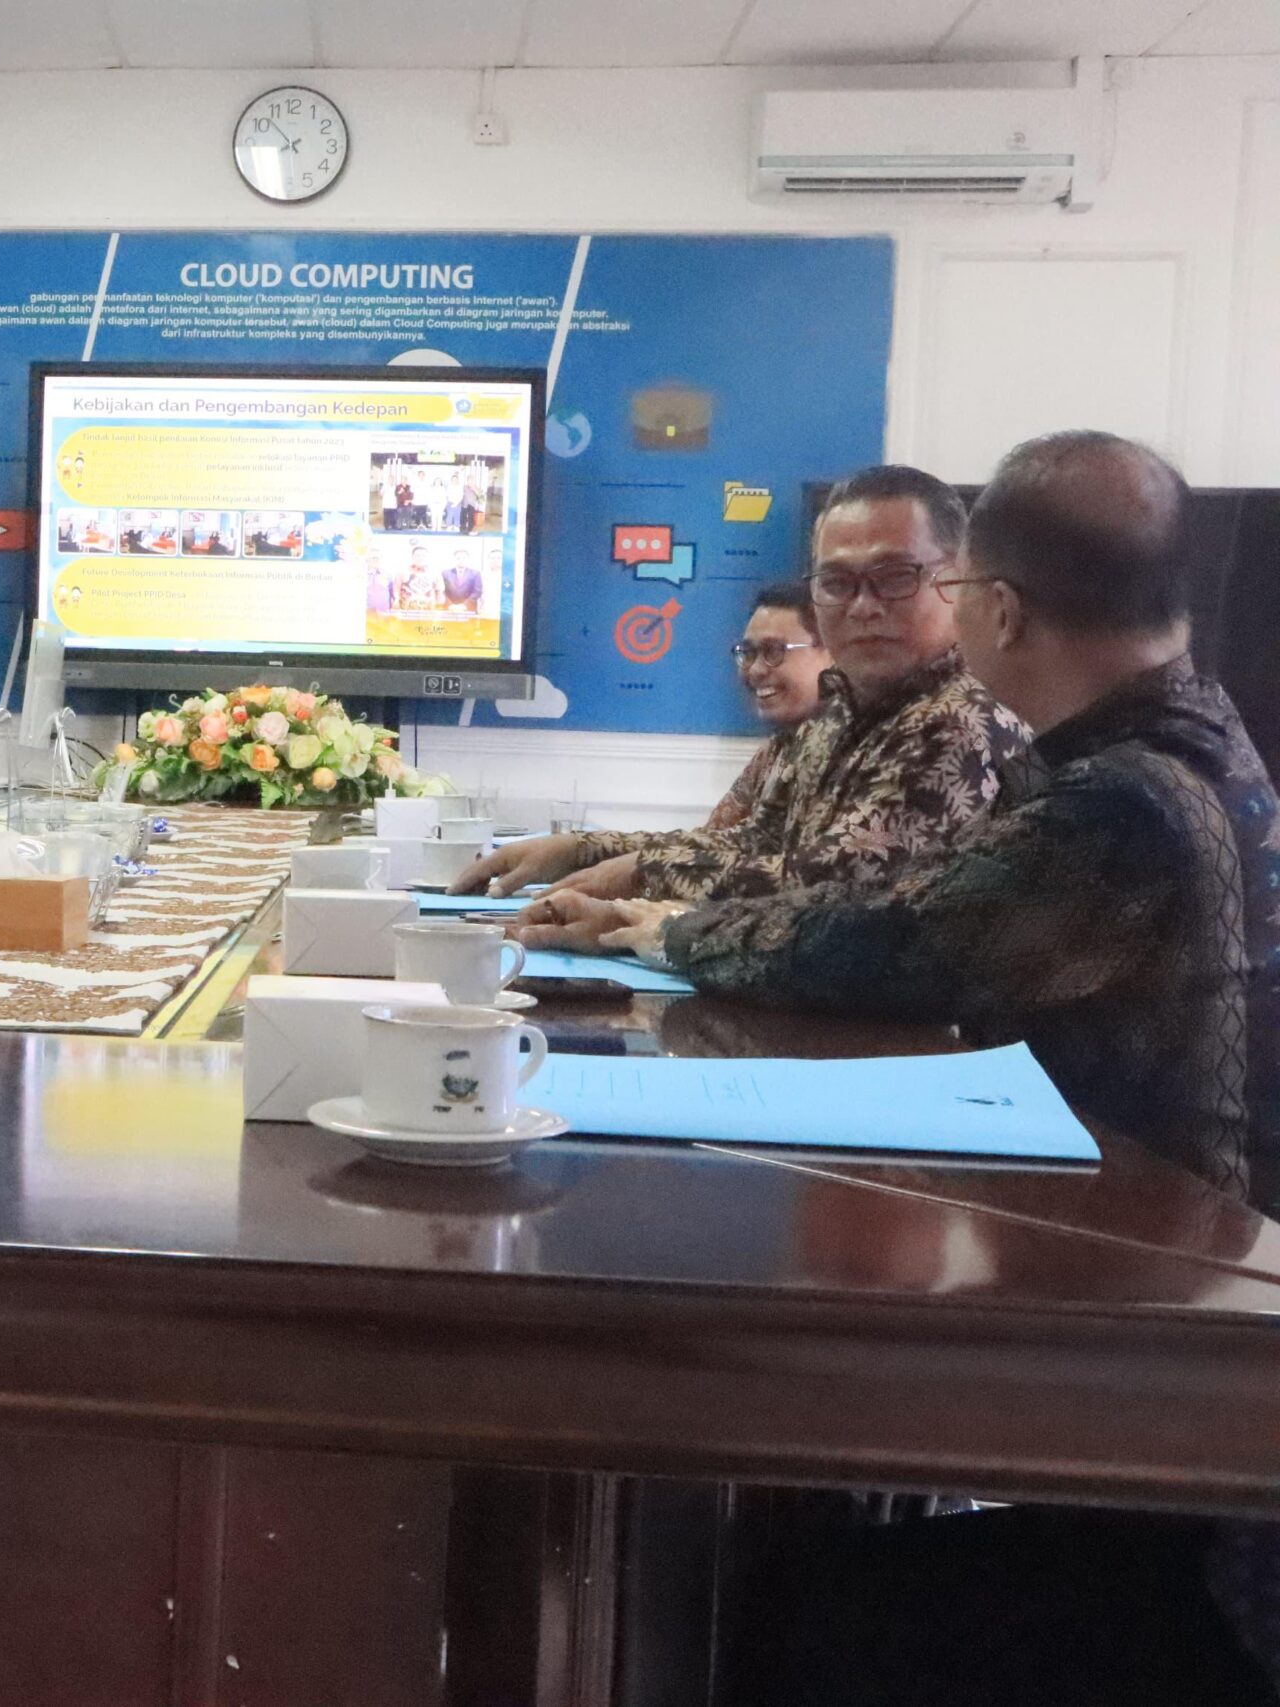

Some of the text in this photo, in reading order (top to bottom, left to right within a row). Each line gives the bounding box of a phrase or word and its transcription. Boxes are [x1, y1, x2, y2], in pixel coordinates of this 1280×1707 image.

[268, 103, 281, 119] 11
[285, 98, 302, 114] 12
[310, 104, 317, 120] 1
[253, 117, 271, 133] 10
[320, 118, 332, 135] 2
[326, 138, 338, 155] 3
[317, 158, 330, 173] 4
[302, 172, 313, 188] 5
[180, 263, 475, 289] CLOUD COMPUTING
[30, 293, 79, 304] gabungan
[155, 293, 202, 304] teknologi
[204, 294, 253, 304] komputer
[323, 294, 342, 303] dan
[344, 296, 422, 306] pengembangan
[426, 295, 470, 305] berbasis
[21, 304, 56, 314] (cloud)
[58, 304, 92, 313] adalah
[101, 304, 145, 314] metafora
[148, 304, 167, 314] dari
[213, 305, 280, 317] sebagaimana
[283, 307, 310, 315] awan
[312, 307, 337, 317] yang
[339, 306, 371, 317] sering
[374, 306, 441, 318] digambarkan
[444, 307, 454, 316] di
[456, 307, 498, 319] diagram
[500, 307, 543, 319] jaringan
[39, 317, 66, 325] awan
[107, 316, 148, 328] diagram
[150, 316, 192, 328] jaringan
[194, 316, 242, 328] komputer
[292, 318, 319, 326] awan
[321, 317, 357, 329] (cloud)
[359, 317, 391, 327] dalam
[393, 318, 424, 328] Cloud
[426, 319, 483, 330] Computing
[485, 320, 508, 331] juga
[582, 321, 630, 331] abstraksi
[162, 328, 181, 338] dari
[184, 328, 246, 338] infrastruktur
[248, 329, 297, 340] kompleks
[299, 331, 325, 341] yang
[73, 398, 409, 419] Kebijakan dan Pengembangan Kedepan
